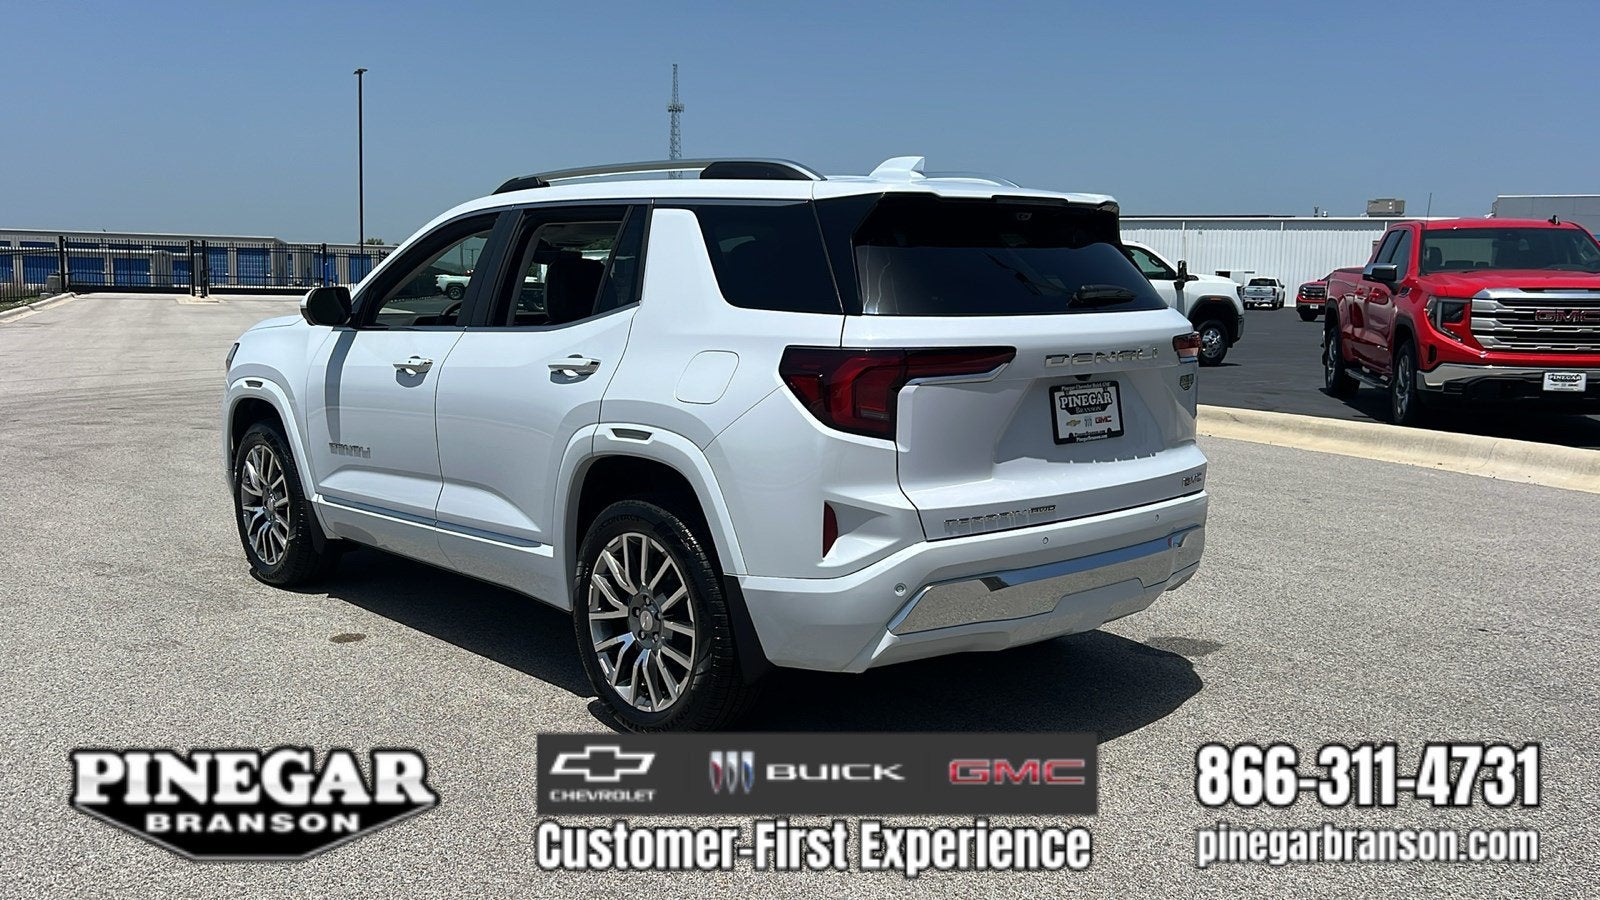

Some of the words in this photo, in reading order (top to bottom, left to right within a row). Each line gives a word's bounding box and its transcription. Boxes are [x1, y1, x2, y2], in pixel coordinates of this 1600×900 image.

[1534, 309, 1600, 323] GMC
[1044, 347, 1158, 368] DENALI
[1060, 392, 1113, 408] PINEGAR
[1095, 415, 1112, 424] GMC
